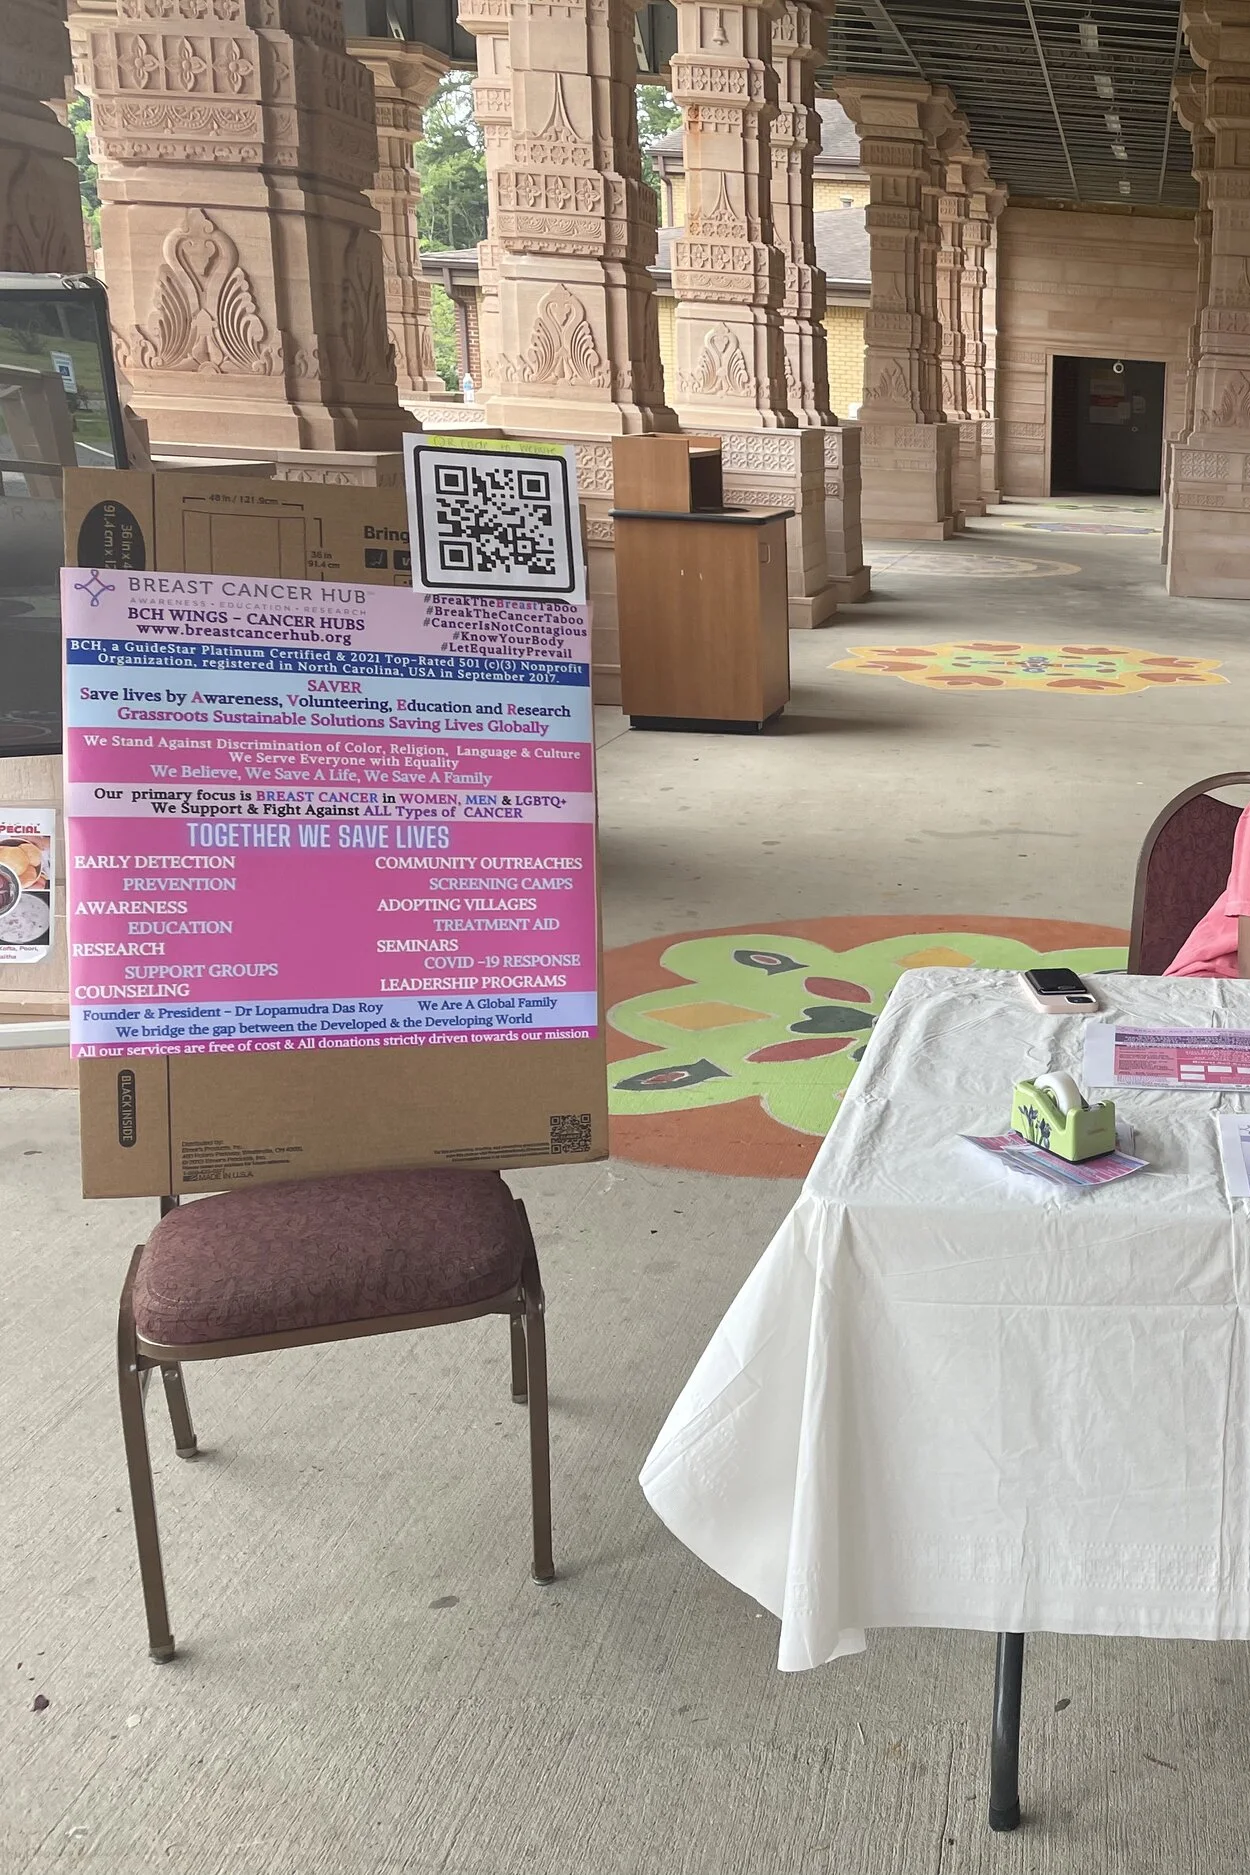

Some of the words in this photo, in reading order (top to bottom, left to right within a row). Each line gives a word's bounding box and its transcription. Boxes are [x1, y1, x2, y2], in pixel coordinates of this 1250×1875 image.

[104, 505, 116, 527] 91.4
[104, 530, 113, 547] cm
[129, 577, 213, 595] BREAST
[222, 582, 312, 600] CANCER
[321, 589, 365, 604] HUB
[130, 597, 206, 607] AWARENESS
[220, 601, 291, 612] EDUCATION
[304, 607, 366, 616] RESEARCH
[423, 594, 577, 613] #BreakTheBreastTaboo
[128, 608, 164, 620] BCH
[169, 610, 227, 623] WINGS
[247, 613, 315, 628] CANCER
[321, 617, 365, 630] HUBS
[426, 606, 584, 625] #BreakTheCancerTaboo
[137, 624, 351, 646] www.breastcancerhub.org
[423, 618, 587, 637] #CancerIsNotContagious
[453, 631, 564, 648] #KnowYourBody
[71, 640, 106, 652] BCH,
[112, 643, 119, 651] a
[125, 642, 196, 655] GuideStar
[201, 645, 264, 658] Platinum
[270, 649, 331, 661] Certified
[336, 652, 345, 661] &
[351, 653, 381, 663] 2021
[384, 654, 454, 667] Top-Rated
[459, 657, 479, 668] 501
[484, 659, 516, 672] (c)(3)
[521, 661, 582, 674] Nonprofit
[441, 642, 572, 660] #LetEqualityPrevail
[307, 680, 362, 693] SAVER
[80, 688, 119, 701] Save
[123, 688, 161, 702] lives
[166, 690, 187, 705] by
[191, 691, 283, 708] Awareness,
[287, 695, 393, 713] Volunteering,
[397, 699, 472, 713] Education
[476, 702, 503, 714] and
[507, 703, 571, 717] Research
[117, 707, 209, 723] Grassroots
[213, 710, 306, 725] Sustainable
[311, 714, 384, 729] Solutions
[389, 717, 441, 733] Saving
[445, 719, 483, 732] Lives
[488, 721, 549, 736] Globally
[83, 735, 107, 746] We
[112, 736, 154, 747] Stand
[158, 737, 212, 751] Against
[216, 739, 322, 752] Discrimination
[327, 741, 341, 752] of
[344, 742, 386, 755] Color,
[390, 744, 449, 757] Religion,
[457, 746, 517, 759] Language
[521, 749, 530, 758] &
[534, 749, 581, 759] Culture
[95, 789, 123, 799] Our
[132, 789, 192, 802] primary
[197, 789, 236, 801] focus
[240, 791, 252, 801] is
[256, 791, 314, 802] BREAST
[319, 792, 378, 803] CANCER
[383, 793, 396, 804] in
[400, 794, 461, 806] WOMEN,
[465, 795, 497, 805] MEN
[502, 796, 512, 805] &
[515, 796, 567, 808] LGBTQ+
[187, 823, 290, 848] TOGETHER
[298, 825, 331, 848] WE
[339, 825, 389, 848] SAVE
[396, 826, 449, 848] LIVES
[74, 856, 130, 869] EARLY
[135, 856, 236, 869] DETECTION
[375, 857, 477, 870] COMMUNITY
[480, 857, 582, 870] OUTREACHES
[123, 878, 236, 891] PREVENTION
[429, 878, 517, 890] SCREENING
[521, 878, 573, 890] CAMPS
[75, 901, 188, 915] AWARENESS
[377, 899, 461, 911] ADOPTING
[464, 898, 536, 911] VILLAGES
[128, 921, 233, 935] EDUCATION
[433, 919, 530, 932] TREATMENT
[532, 919, 559, 930] AID
[72, 943, 165, 957] RESEARCH
[377, 939, 459, 952] SEMINARS
[424, 957, 474, 969] COVID
[503, 954, 581, 967] RESPONSE
[124, 965, 205, 979] SUPPORT
[208, 964, 278, 978] GROUPS
[75, 984, 190, 999] COUNSELING
[380, 977, 479, 992] LEADERSHIP
[481, 975, 567, 989] PROGRAMS
[83, 1009, 140, 1021] Founder
[144, 1009, 154, 1019] &
[158, 1007, 220, 1019] President
[235, 1006, 251, 1016] Dr
[256, 1004, 329, 1019] Lopamudra
[332, 1003, 355, 1013] Das
[359, 1003, 383, 1015] Roy
[417, 1000, 438, 1011] We
[441, 1000, 462, 1010] Are
[465, 1000, 474, 1010] A
[477, 998, 515, 1009] Global
[518, 997, 557, 1010] Family
